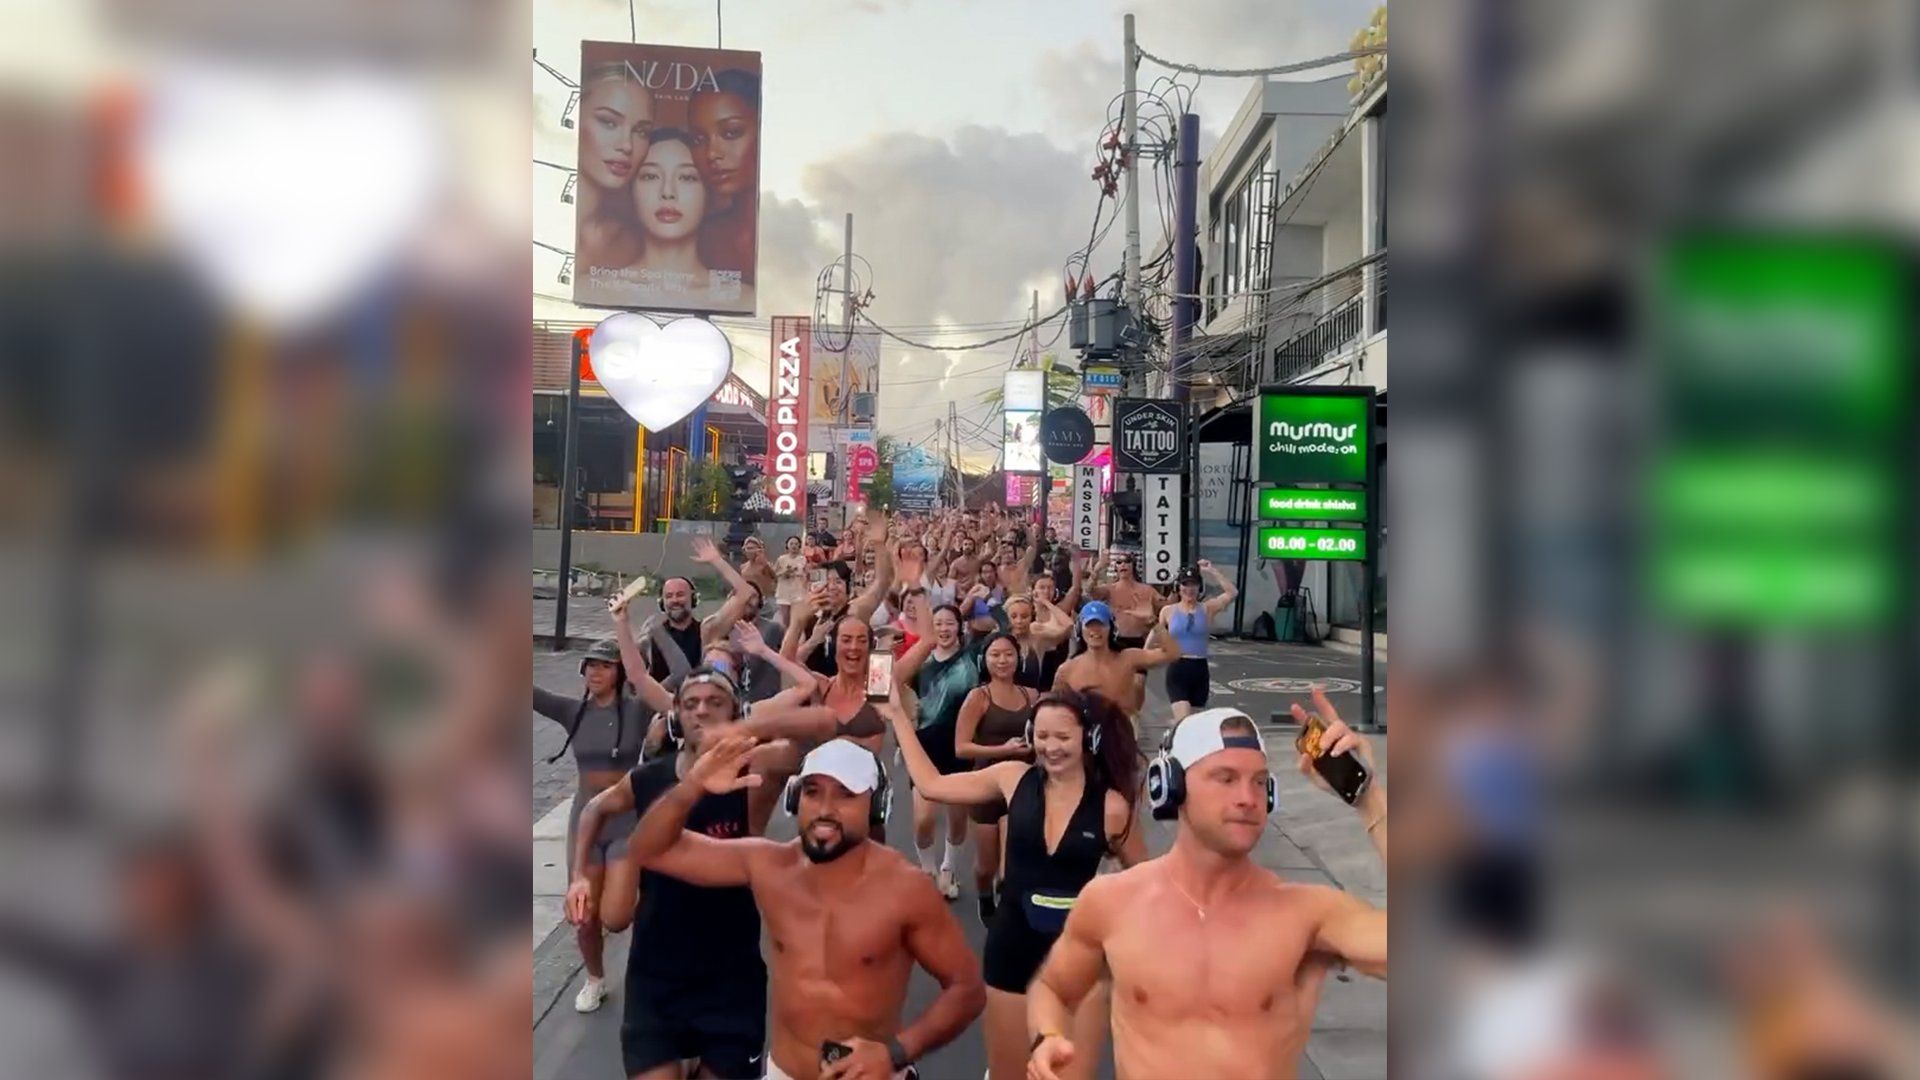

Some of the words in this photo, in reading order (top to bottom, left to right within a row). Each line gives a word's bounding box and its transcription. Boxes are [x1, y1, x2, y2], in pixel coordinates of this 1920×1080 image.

[624, 59, 720, 93] NUDA
[589, 265, 618, 279] Bring
[620, 267, 638, 279] the
[640, 268, 662, 281] Spa
[777, 336, 801, 425] PIZZA
[1125, 412, 1154, 426] UNDER
[1156, 413, 1176, 427] SKIN
[1050, 430, 1083, 442] AMY
[1124, 430, 1175, 451] TATTOO
[1269, 421, 1357, 442] murmur
[1269, 442, 1297, 454] chill
[774, 431, 798, 515] DODO
[1081, 467, 1094, 548] MASSAGE
[1269, 498, 1293, 509] food
[1294, 499, 1321, 510] drink
[1156, 477, 1170, 582] TATTOO
[1268, 536, 1306, 550] 08.00
[1317, 537, 1357, 552] 02.00
